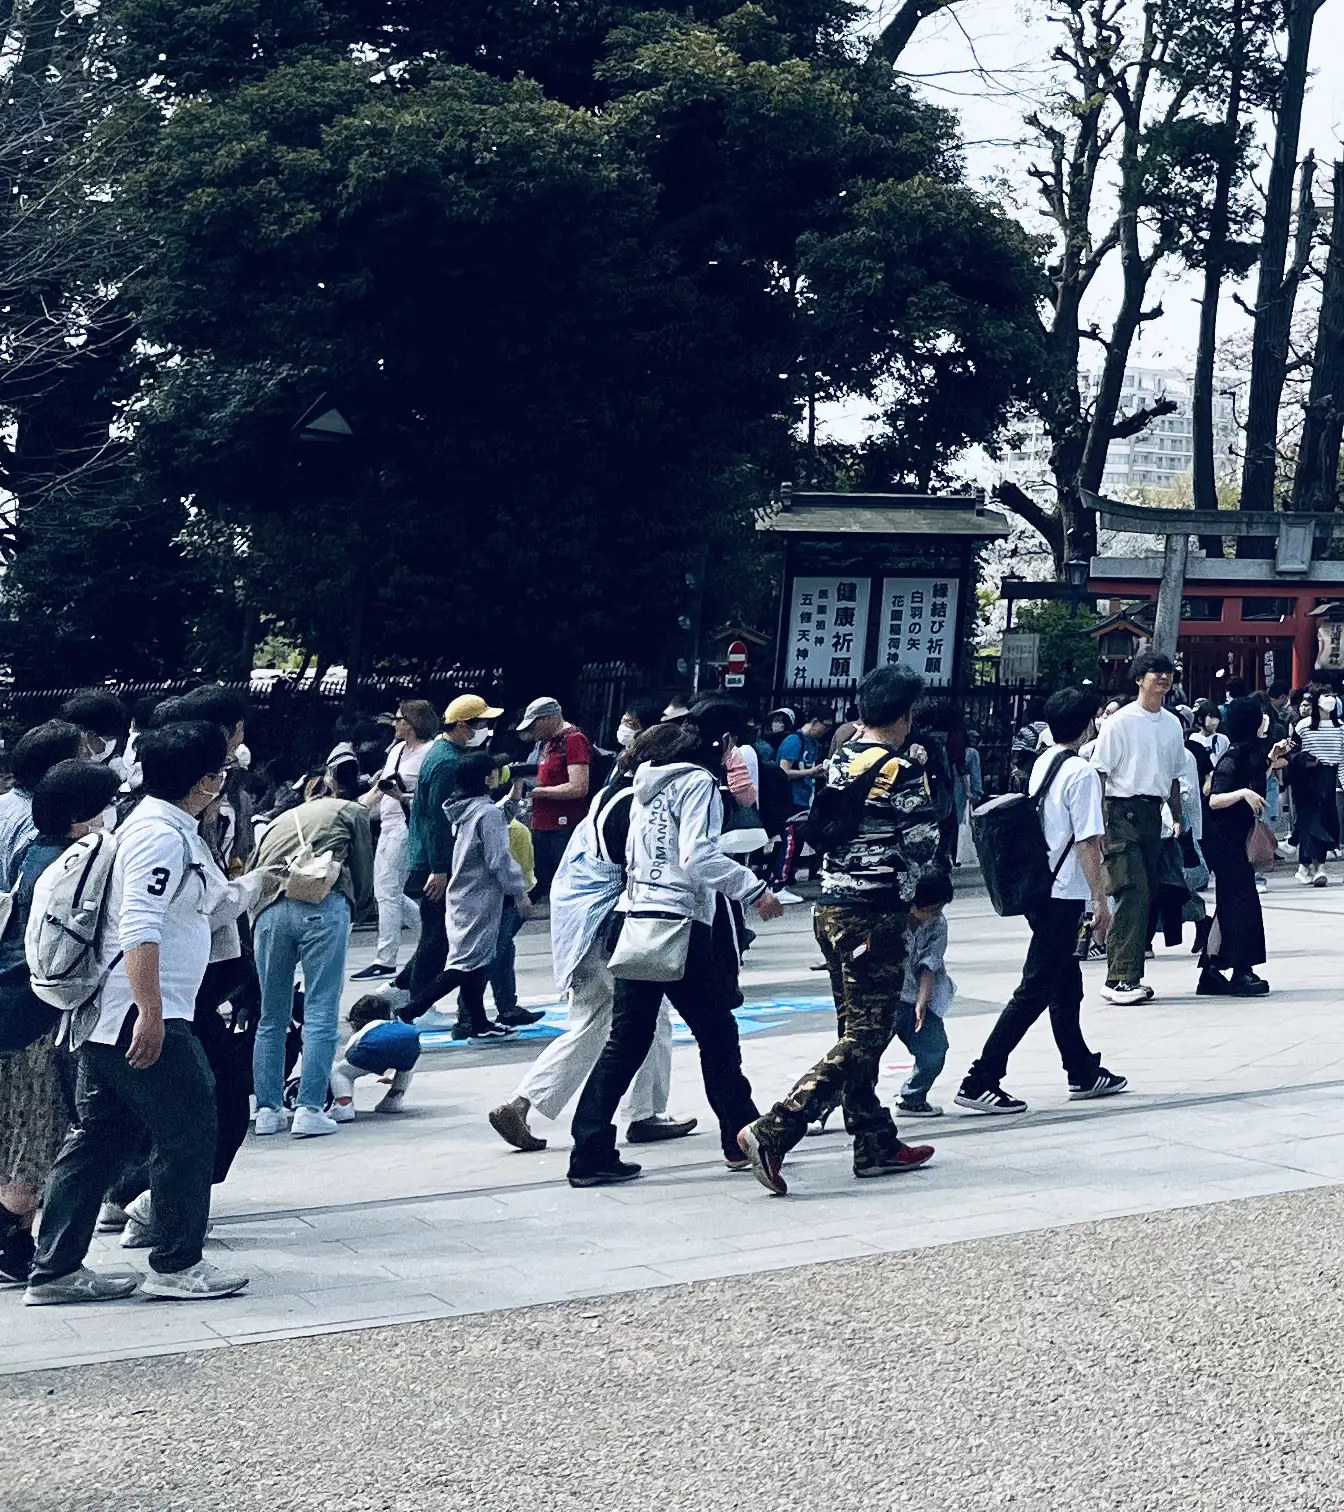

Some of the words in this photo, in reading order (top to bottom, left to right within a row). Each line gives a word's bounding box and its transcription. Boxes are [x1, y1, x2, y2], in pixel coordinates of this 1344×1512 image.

[830, 582, 857, 677] 健康祈願
[907, 590, 924, 651] 白羽の矢
[925, 582, 949, 674] 縁結び祈願
[147, 867, 170, 896] 3
